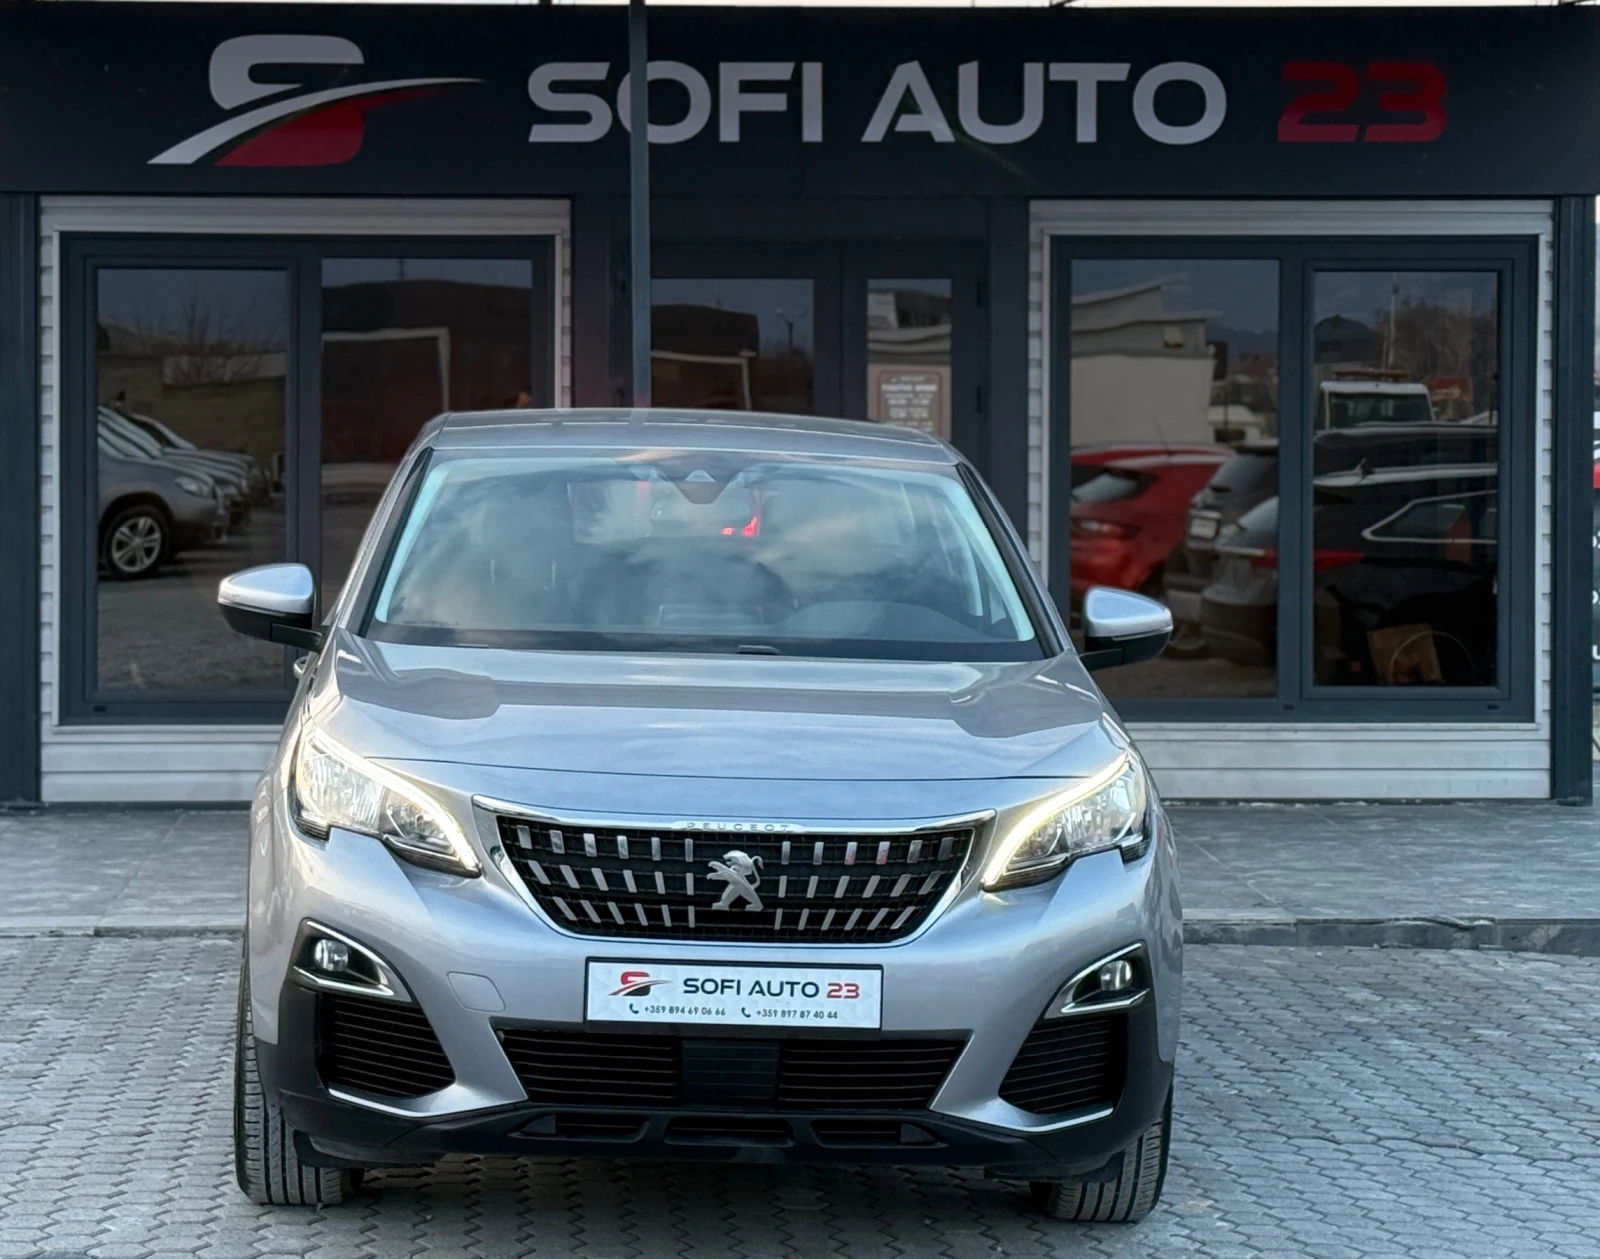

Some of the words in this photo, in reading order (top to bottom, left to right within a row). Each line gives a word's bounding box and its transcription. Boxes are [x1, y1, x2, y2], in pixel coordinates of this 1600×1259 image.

[527, 60, 823, 144] SOFI
[861, 60, 1227, 145] AUTO
[1277, 61, 1447, 143] 23
[683, 977, 742, 996] SOFI
[748, 979, 820, 999] AUTO
[826, 982, 861, 999] 23
[644, 1005, 667, 1014] +359
[668, 1005, 686, 1015] 894
[687, 1006, 699, 1015] 69
[701, 1006, 713, 1016] 06
[715, 1007, 727, 1016] 66
[756, 1008, 779, 1018] +359
[780, 1009, 797, 1018] 897
[799, 1010, 811, 1019] 87
[813, 1010, 825, 1019] 40
[827, 1010, 838, 1019] 44
